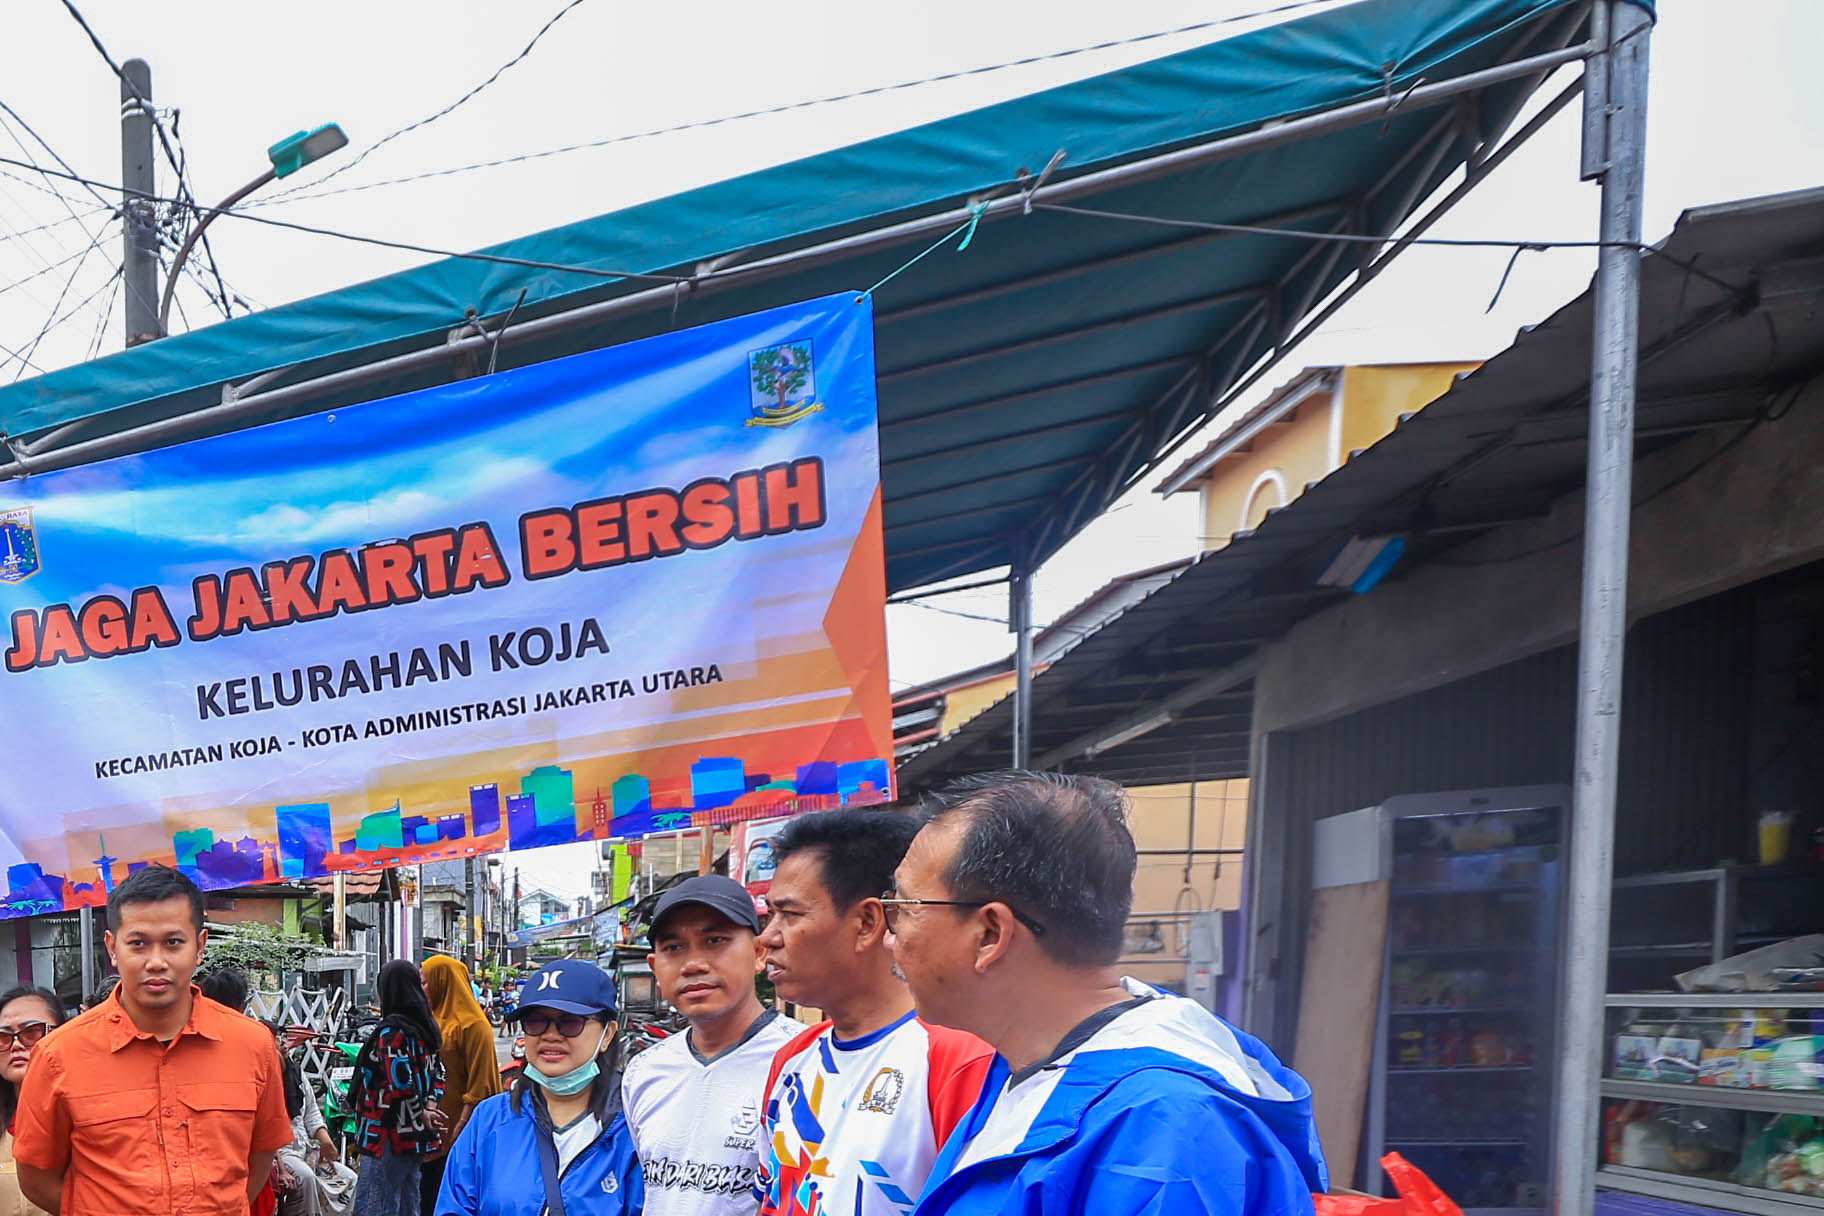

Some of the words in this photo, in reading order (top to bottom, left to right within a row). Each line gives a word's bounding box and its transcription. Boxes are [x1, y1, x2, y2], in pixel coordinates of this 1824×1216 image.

[5, 586, 180, 672] JAGA
[188, 522, 510, 642] JAKARTA
[519, 455, 826, 581] BERSIH
[196, 640, 473, 720] KELURAHAN
[488, 618, 610, 672] KOJA
[95, 744, 223, 778] KECAMATAN
[229, 735, 282, 760] KOJA
[302, 724, 358, 748] KOTA
[364, 697, 527, 738] ADMINISTRASI
[533, 679, 635, 712] JAKARTA
[642, 664, 723, 693] UTARA
[702, 1162, 755, 1194] BIAS
[723, 1135, 756, 1151] SUPER
